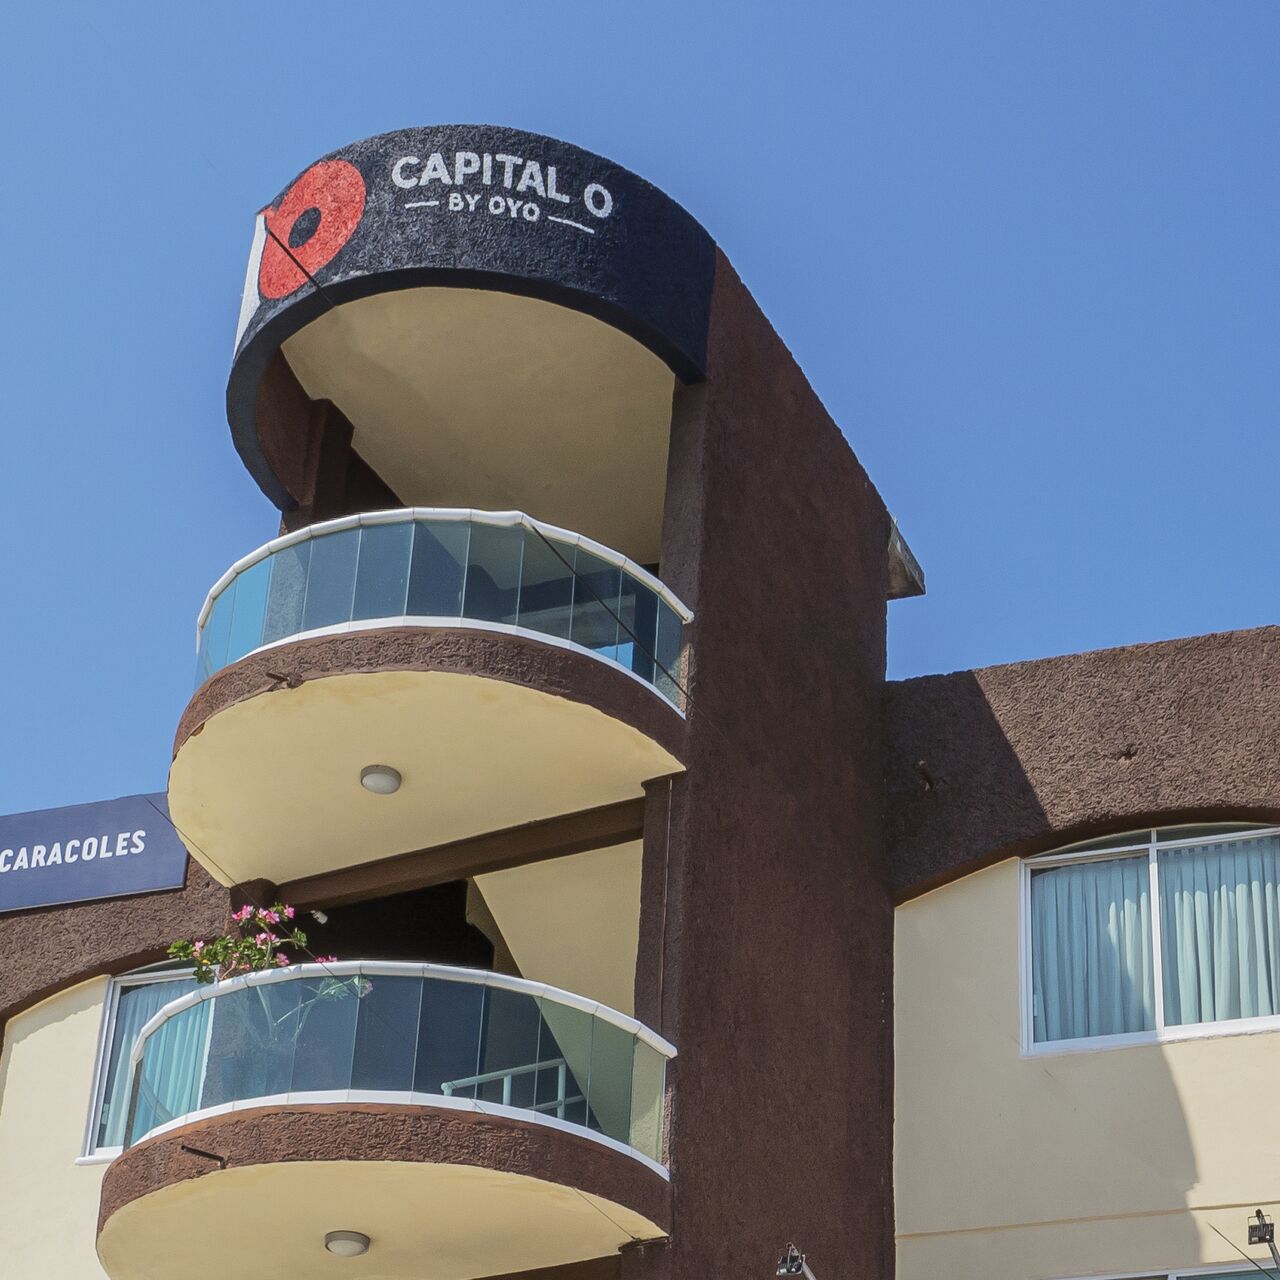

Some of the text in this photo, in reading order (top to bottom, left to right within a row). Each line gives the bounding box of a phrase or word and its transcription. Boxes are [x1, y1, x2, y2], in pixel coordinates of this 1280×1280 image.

[391, 151, 613, 218] CAPITAL O
[448, 192, 541, 222] BY OYO
